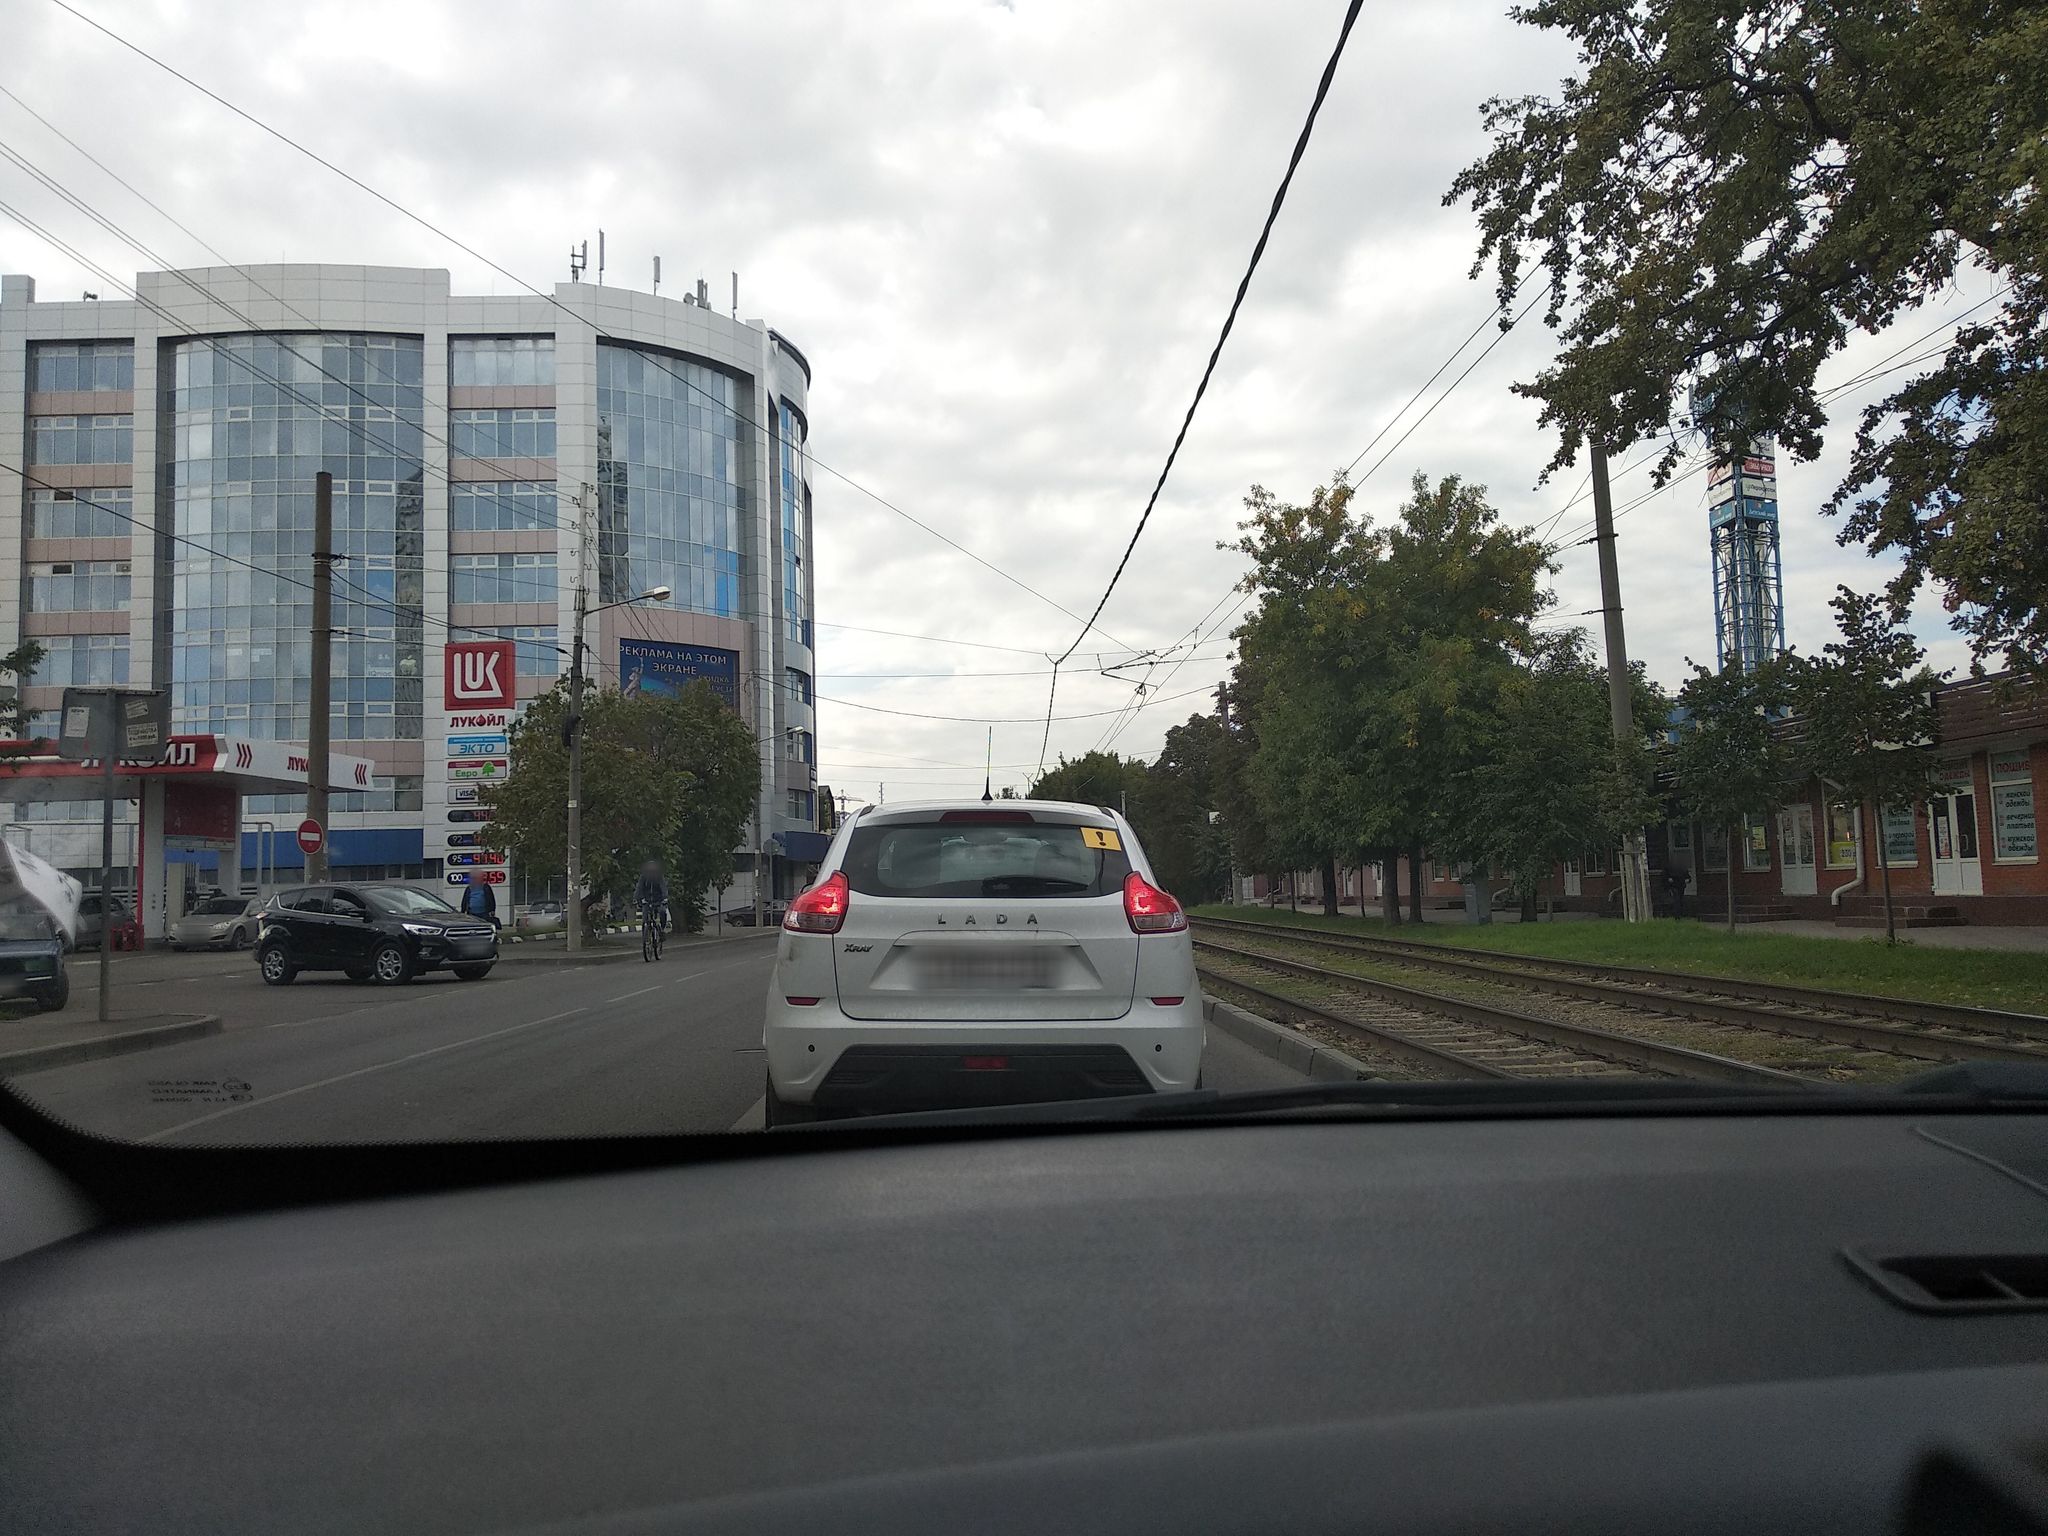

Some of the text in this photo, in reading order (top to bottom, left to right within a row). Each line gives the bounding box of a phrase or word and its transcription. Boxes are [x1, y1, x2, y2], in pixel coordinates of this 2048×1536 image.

[620, 645, 727, 665] РЕКЛАМА НА ЭТОМ
[652, 662, 697, 675] ЭКРАНЕ
[459, 744, 495, 754] ЭКТО
[456, 770, 478, 778] Евро
[452, 835, 463, 844] 92
[452, 854, 463, 863] 95
[450, 873, 463, 882] 100
[937, 913, 1038, 925] LADA
